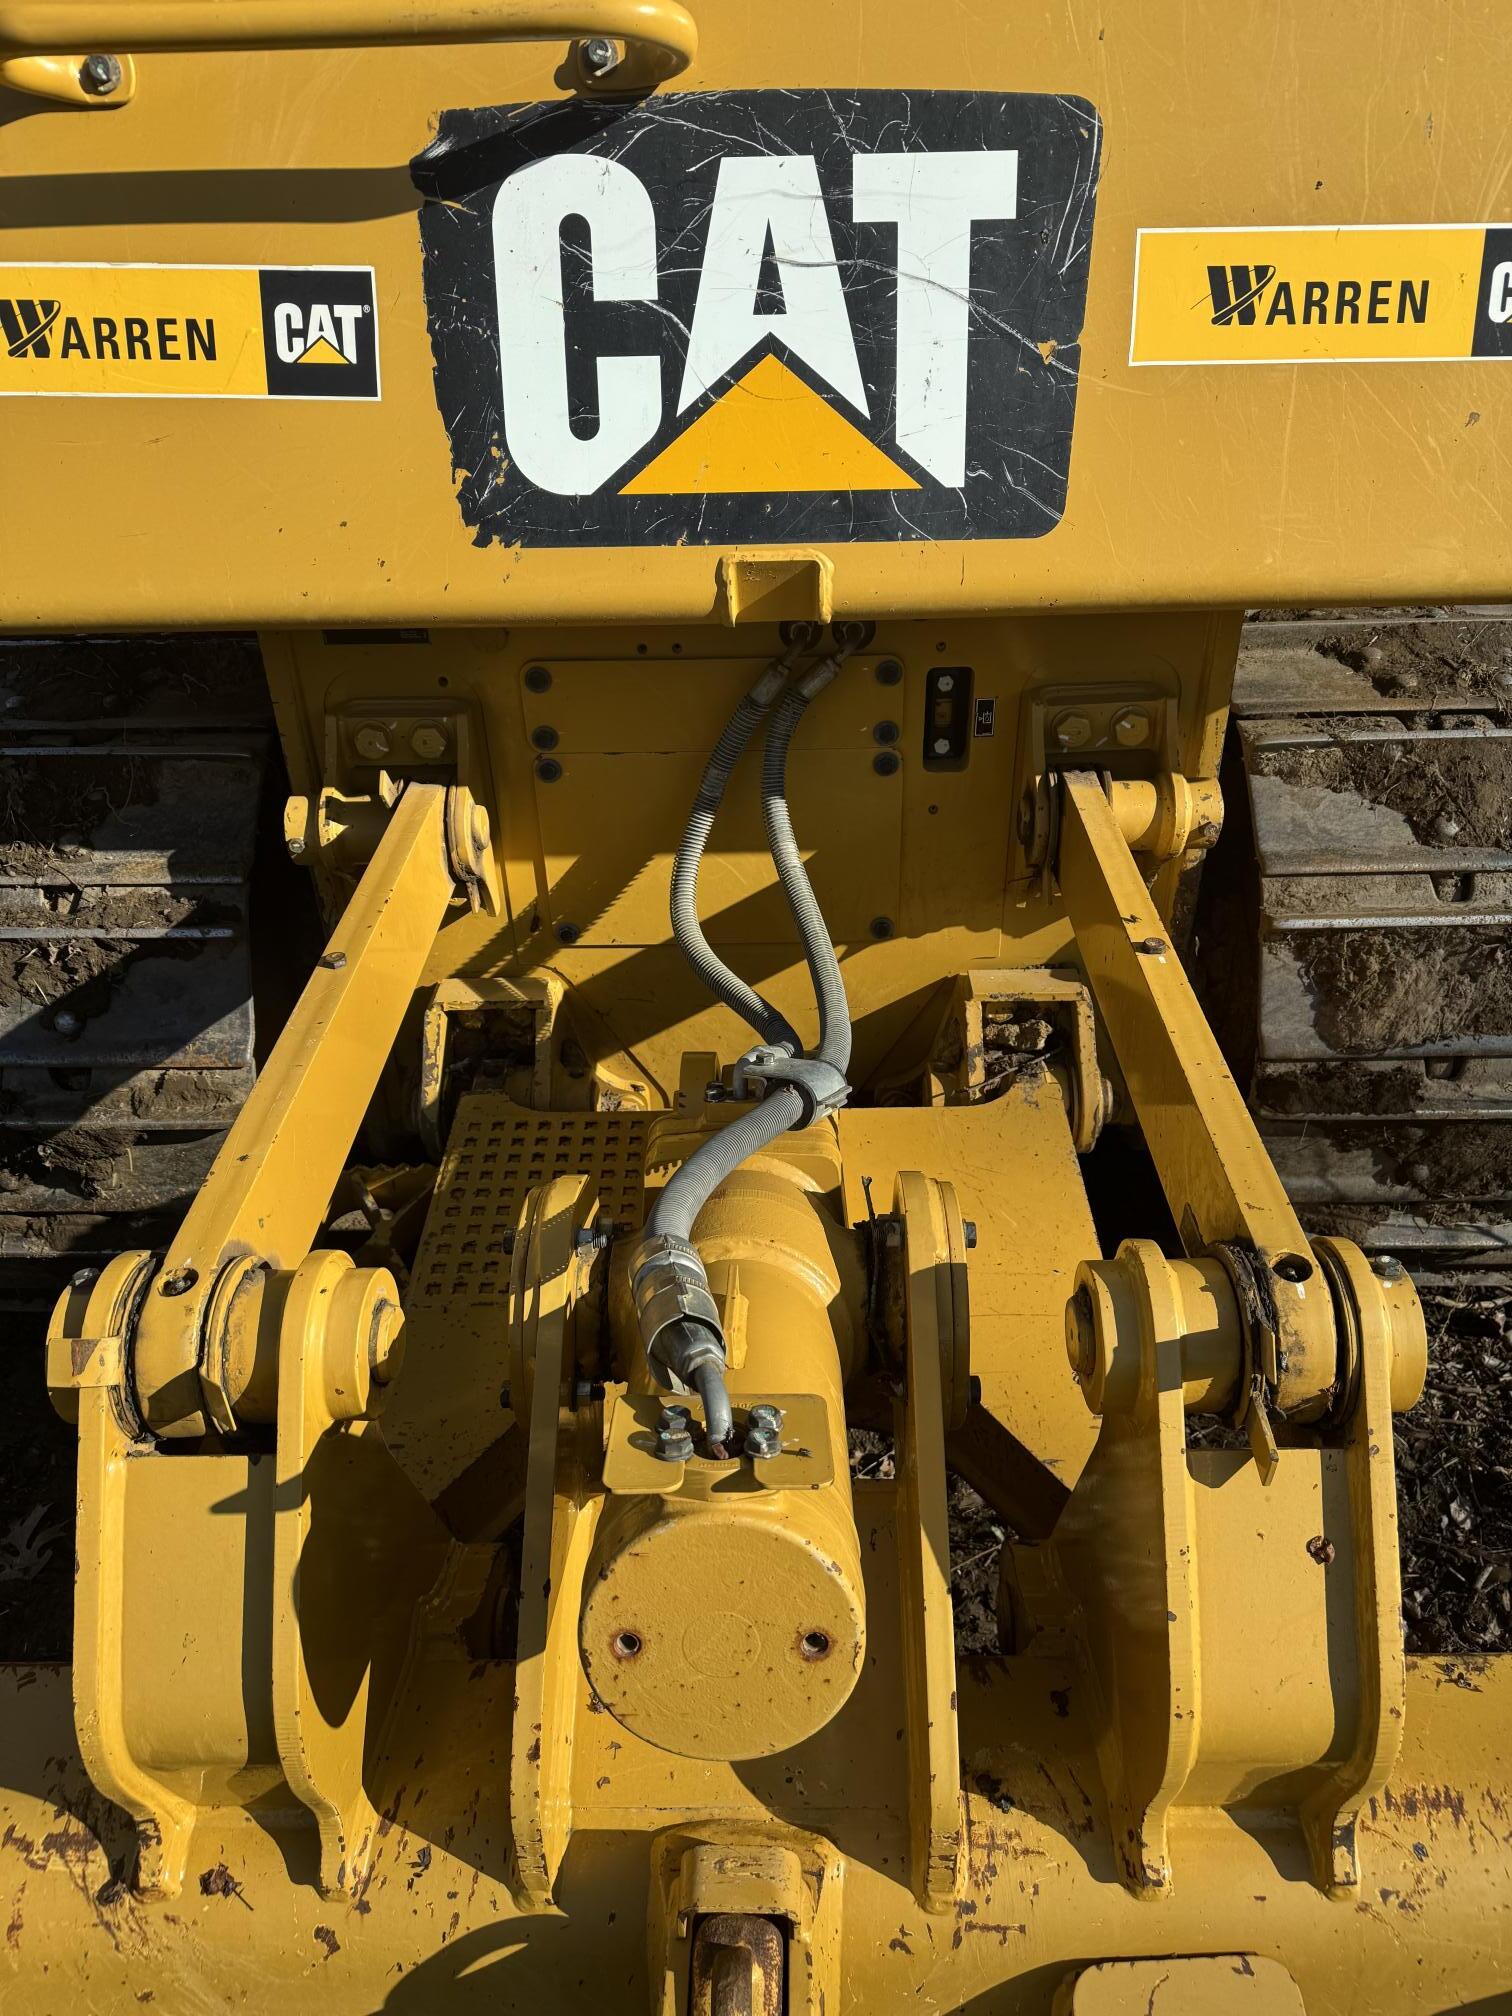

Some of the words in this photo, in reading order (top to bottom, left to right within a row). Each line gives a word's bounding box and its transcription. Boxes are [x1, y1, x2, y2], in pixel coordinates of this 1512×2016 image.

[492, 150, 1018, 495] CAT
[1206, 265, 1429, 325] WARREN
[0, 299, 217, 361] WARREN
